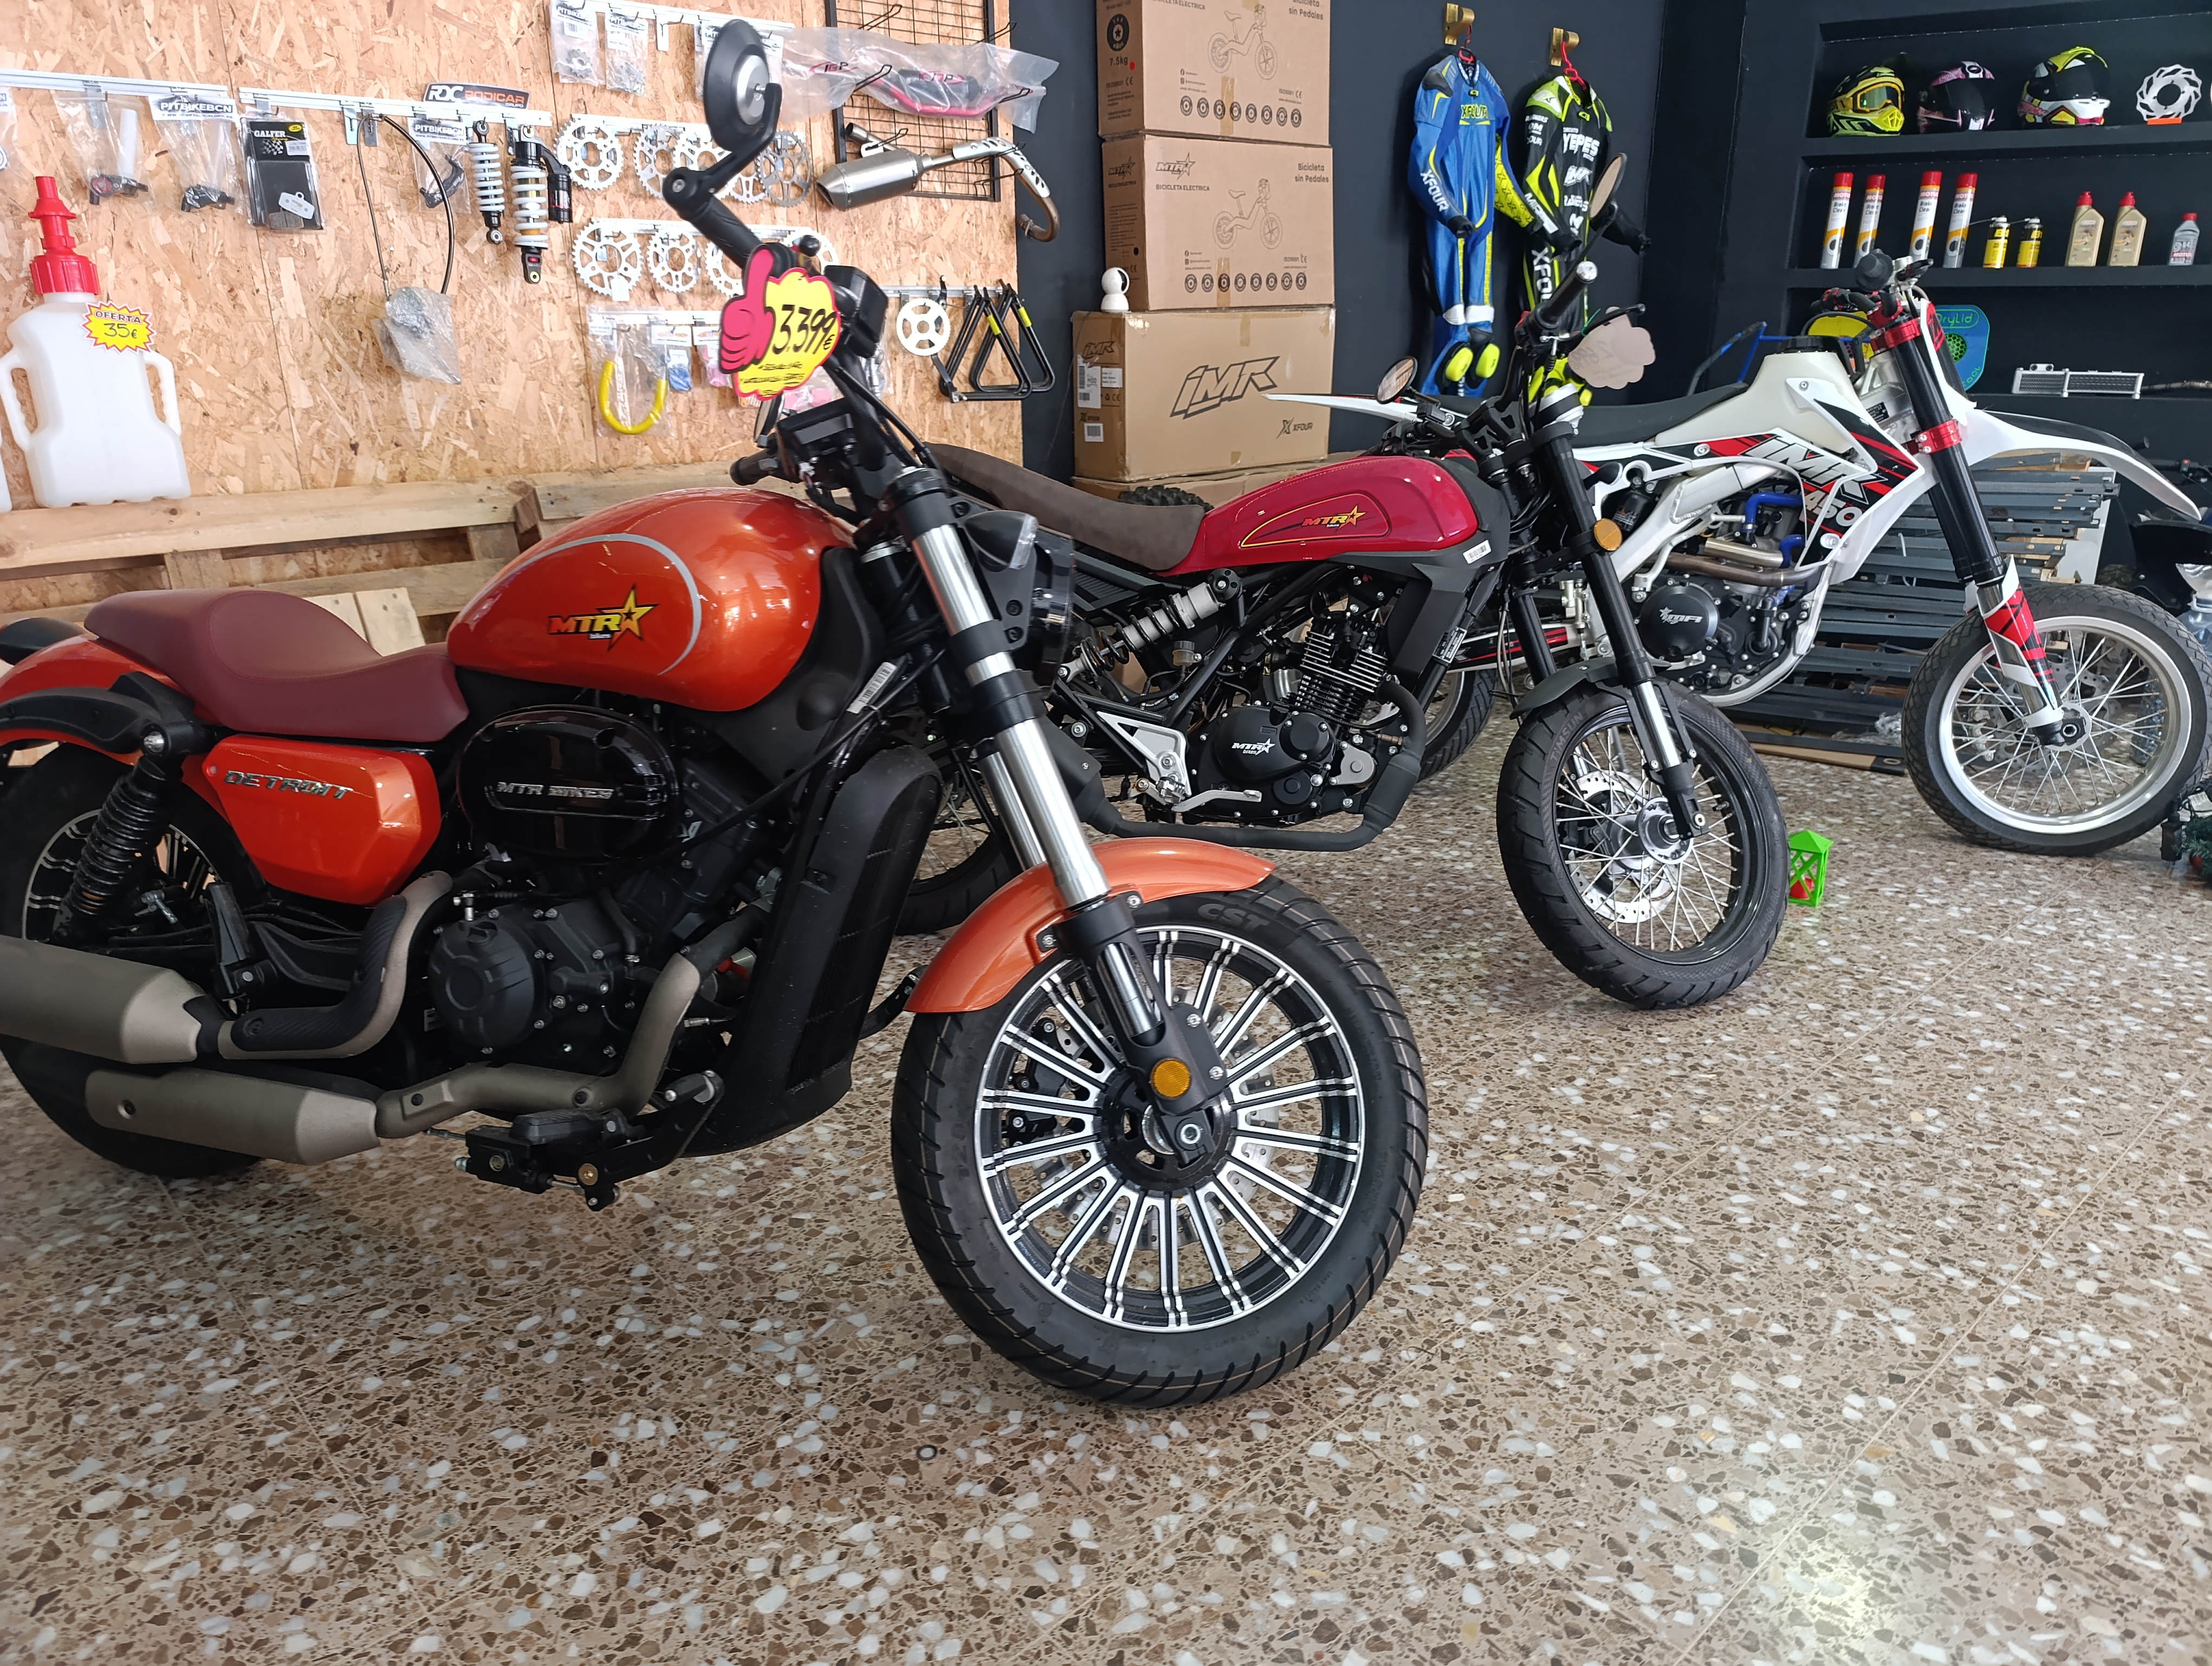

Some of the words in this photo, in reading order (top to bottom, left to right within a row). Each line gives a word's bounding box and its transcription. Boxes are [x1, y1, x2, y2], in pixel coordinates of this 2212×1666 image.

[1179, 1, 1205, 10] ELECTRICA
[1289, 8, 1297, 16] sin
[1300, 8, 1323, 20] Pedales
[1109, 56, 1128, 66] 7.5kg
[428, 85, 464, 101] RDC
[160, 102, 233, 113] PITBIKEBCN
[415, 125, 465, 136] PITBIKEBCN
[1563, 133, 1600, 157] YEPES
[1298, 163, 1324, 172] Bicicleta
[1305, 175, 1329, 183] Pedales
[1420, 169, 1449, 212] XFOUR
[95, 311, 141, 324] OFERTA
[104, 323, 137, 339] 35€
[1804, 489, 1862, 527] 450
[1302, 515, 1349, 526] MTR
[549, 614, 622, 633] MTR
[224, 770, 355, 799] DETROIT
[497, 781, 544, 795] MTR
[548, 785, 615, 799] BIKES
[1197, 903, 1271, 932] CST
